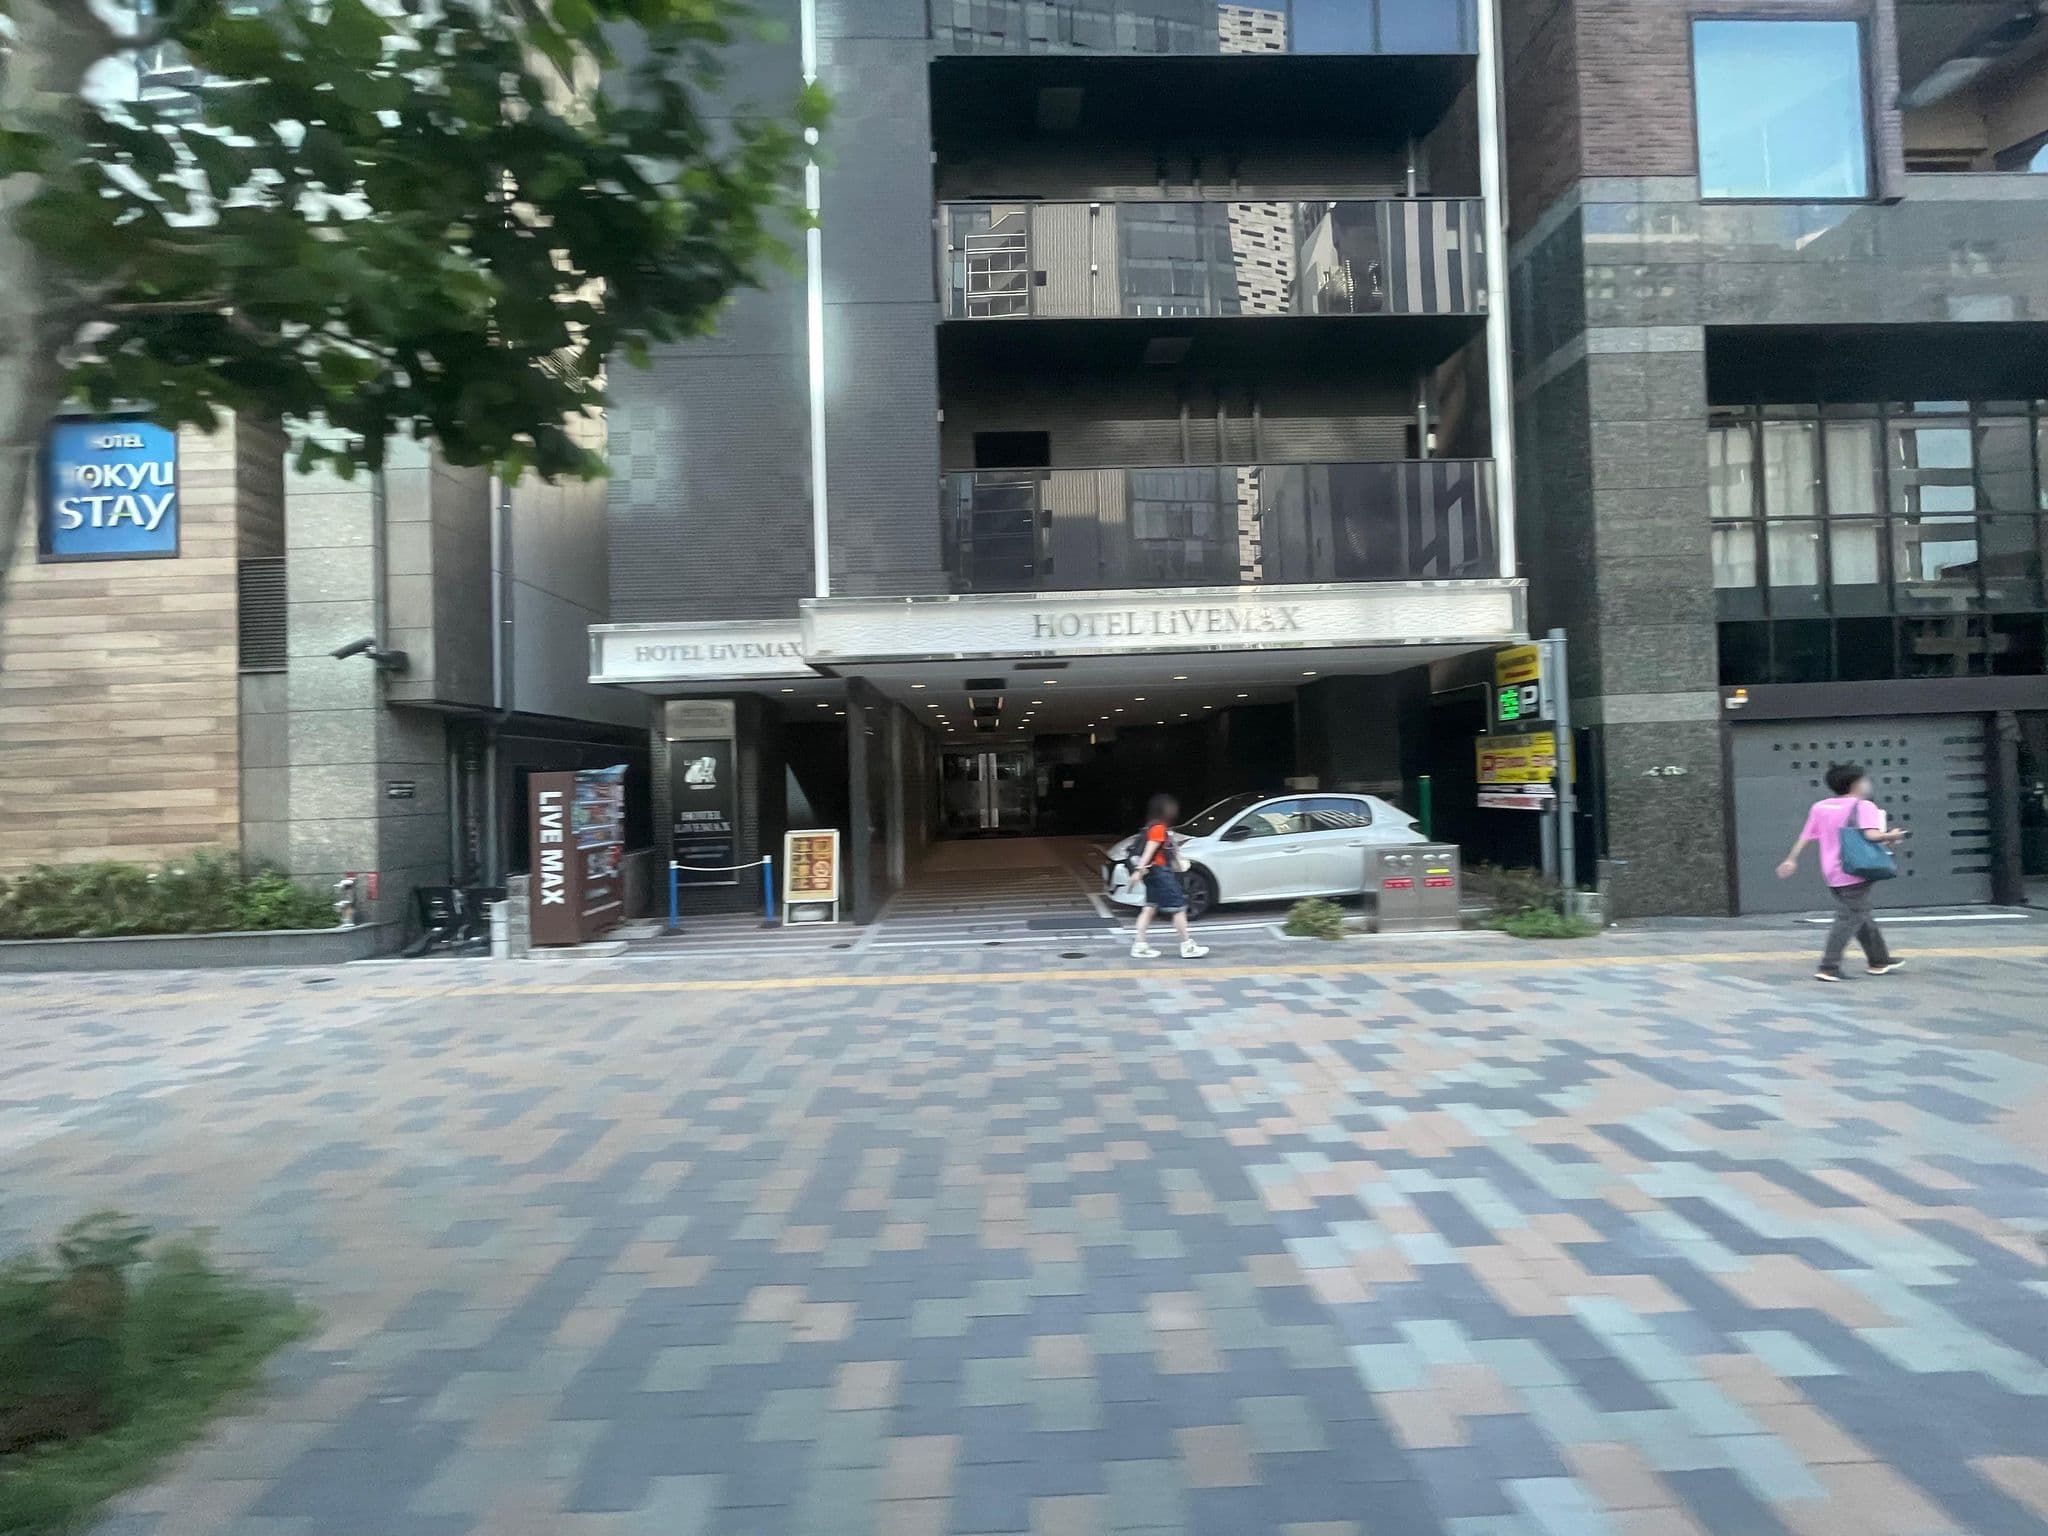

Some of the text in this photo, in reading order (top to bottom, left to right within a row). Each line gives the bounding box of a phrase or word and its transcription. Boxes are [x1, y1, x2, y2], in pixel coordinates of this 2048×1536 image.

[57, 492, 175, 531] STAY
[1033, 610, 1142, 638] HOTEL
[636, 645, 704, 662] HOTEL
[1520, 686, 1538, 713] P
[539, 791, 565, 905] LIVE MAX
